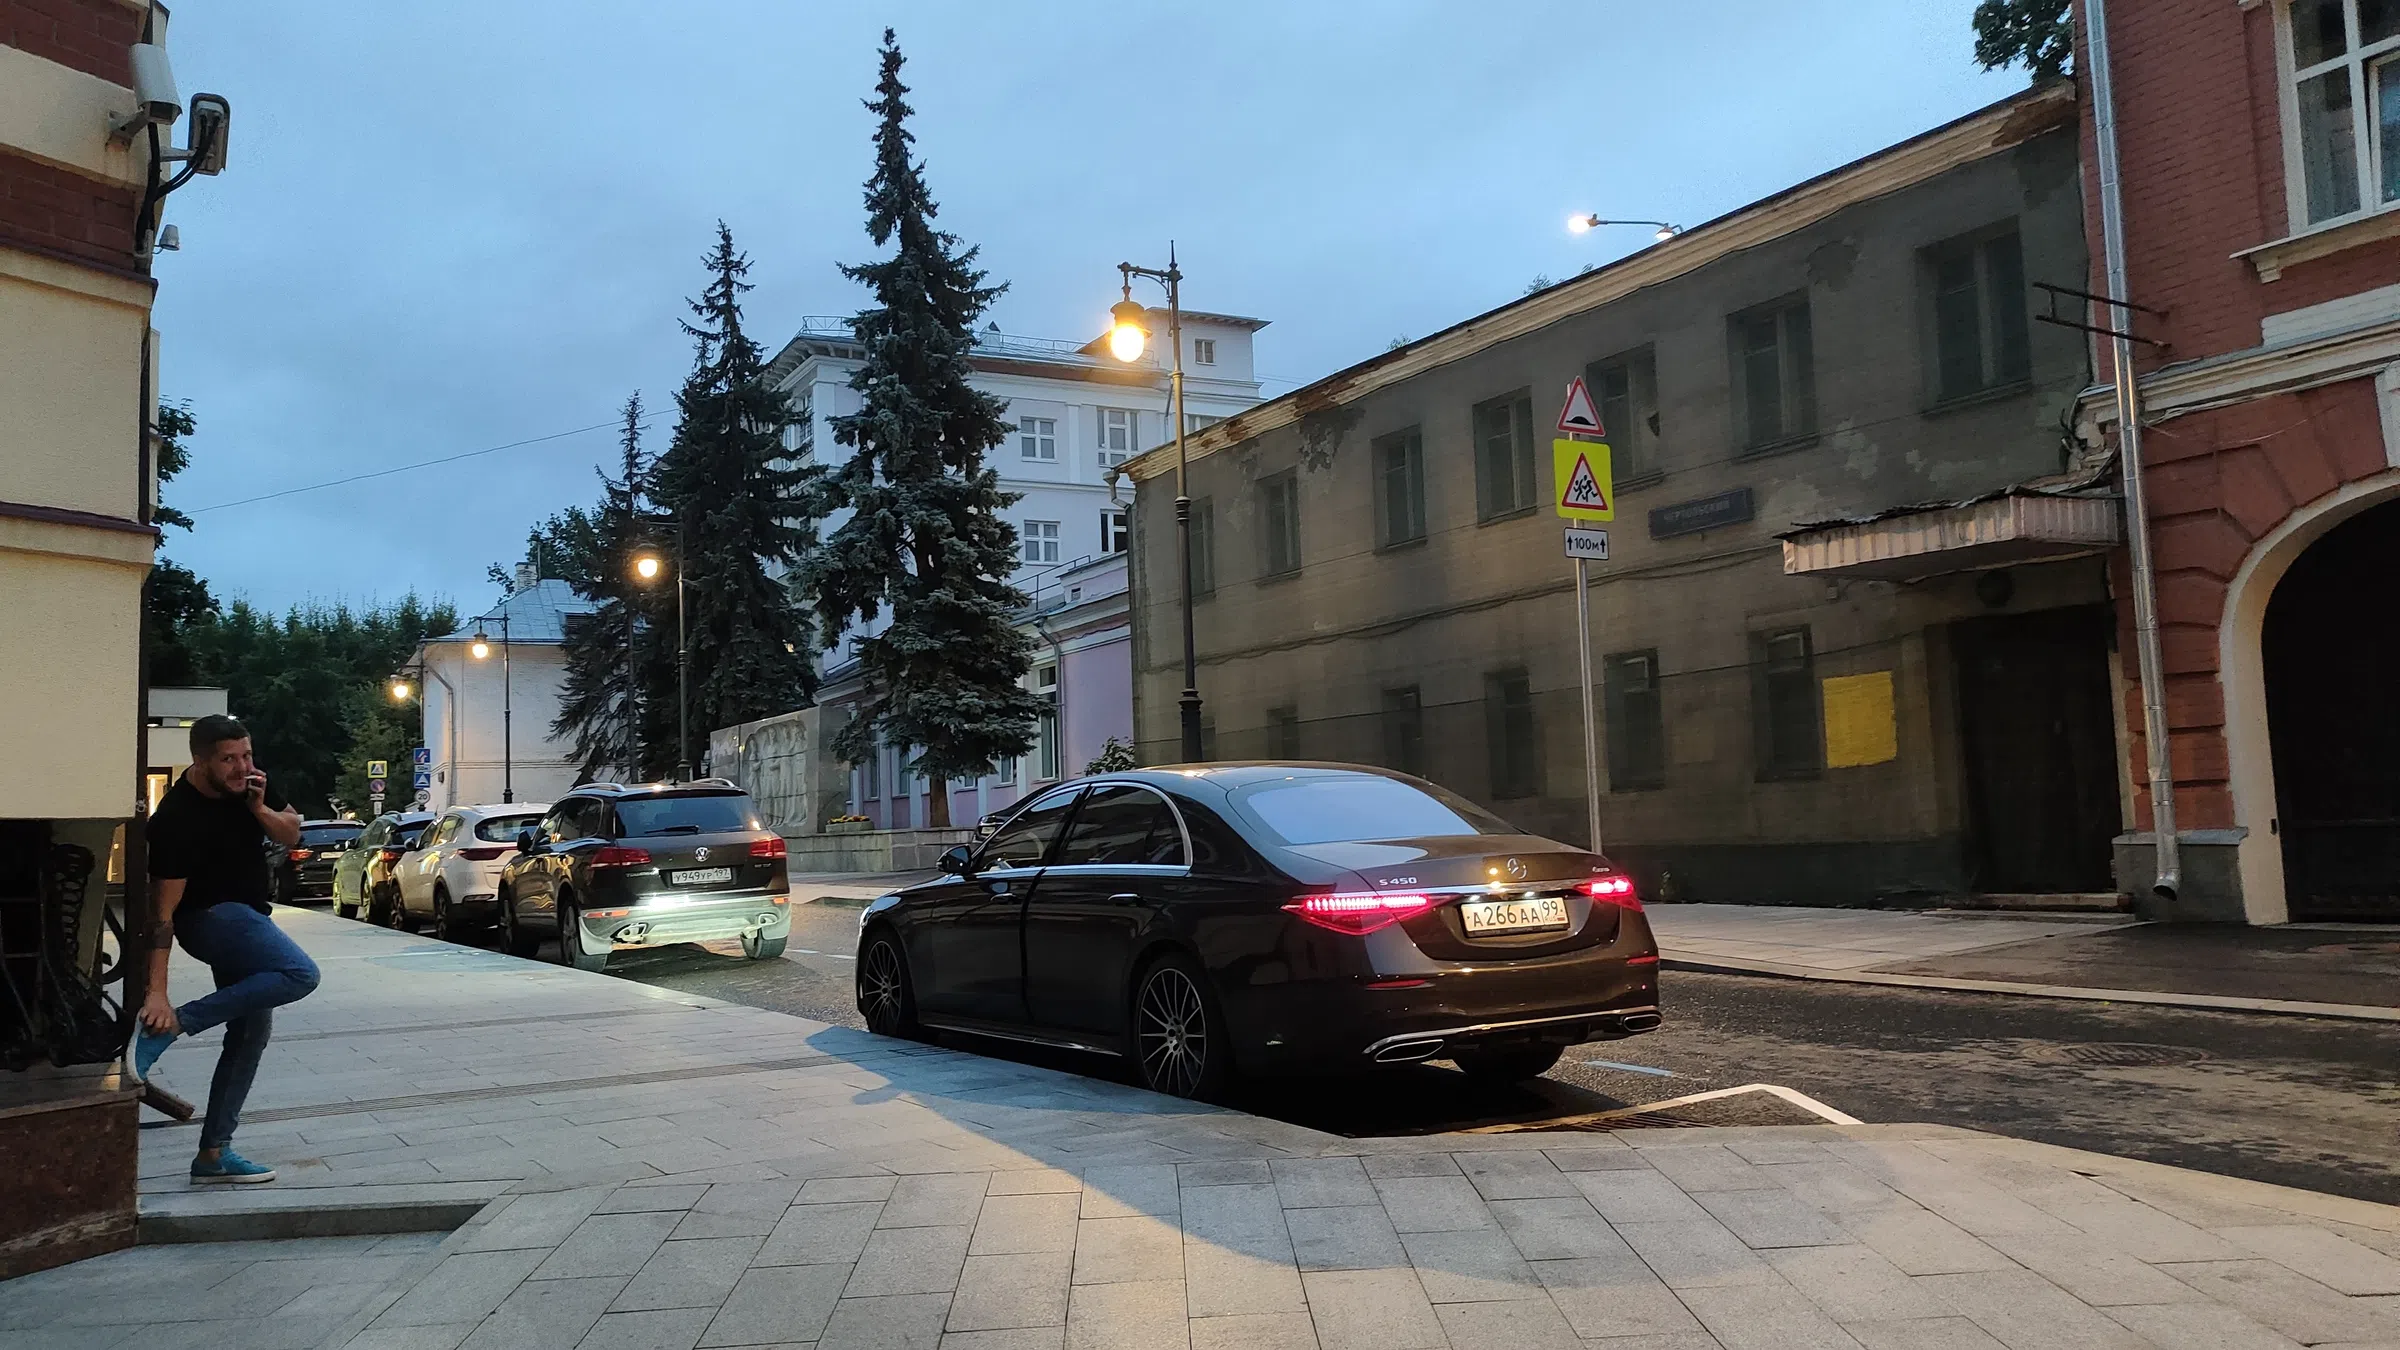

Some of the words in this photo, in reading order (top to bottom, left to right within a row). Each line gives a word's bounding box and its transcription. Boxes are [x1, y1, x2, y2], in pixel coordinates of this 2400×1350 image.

[1574, 537, 1600, 551] 100м
[1379, 878, 1388, 886] S
[1390, 877, 1417, 885] 450
[1542, 900, 1558, 916] 99
